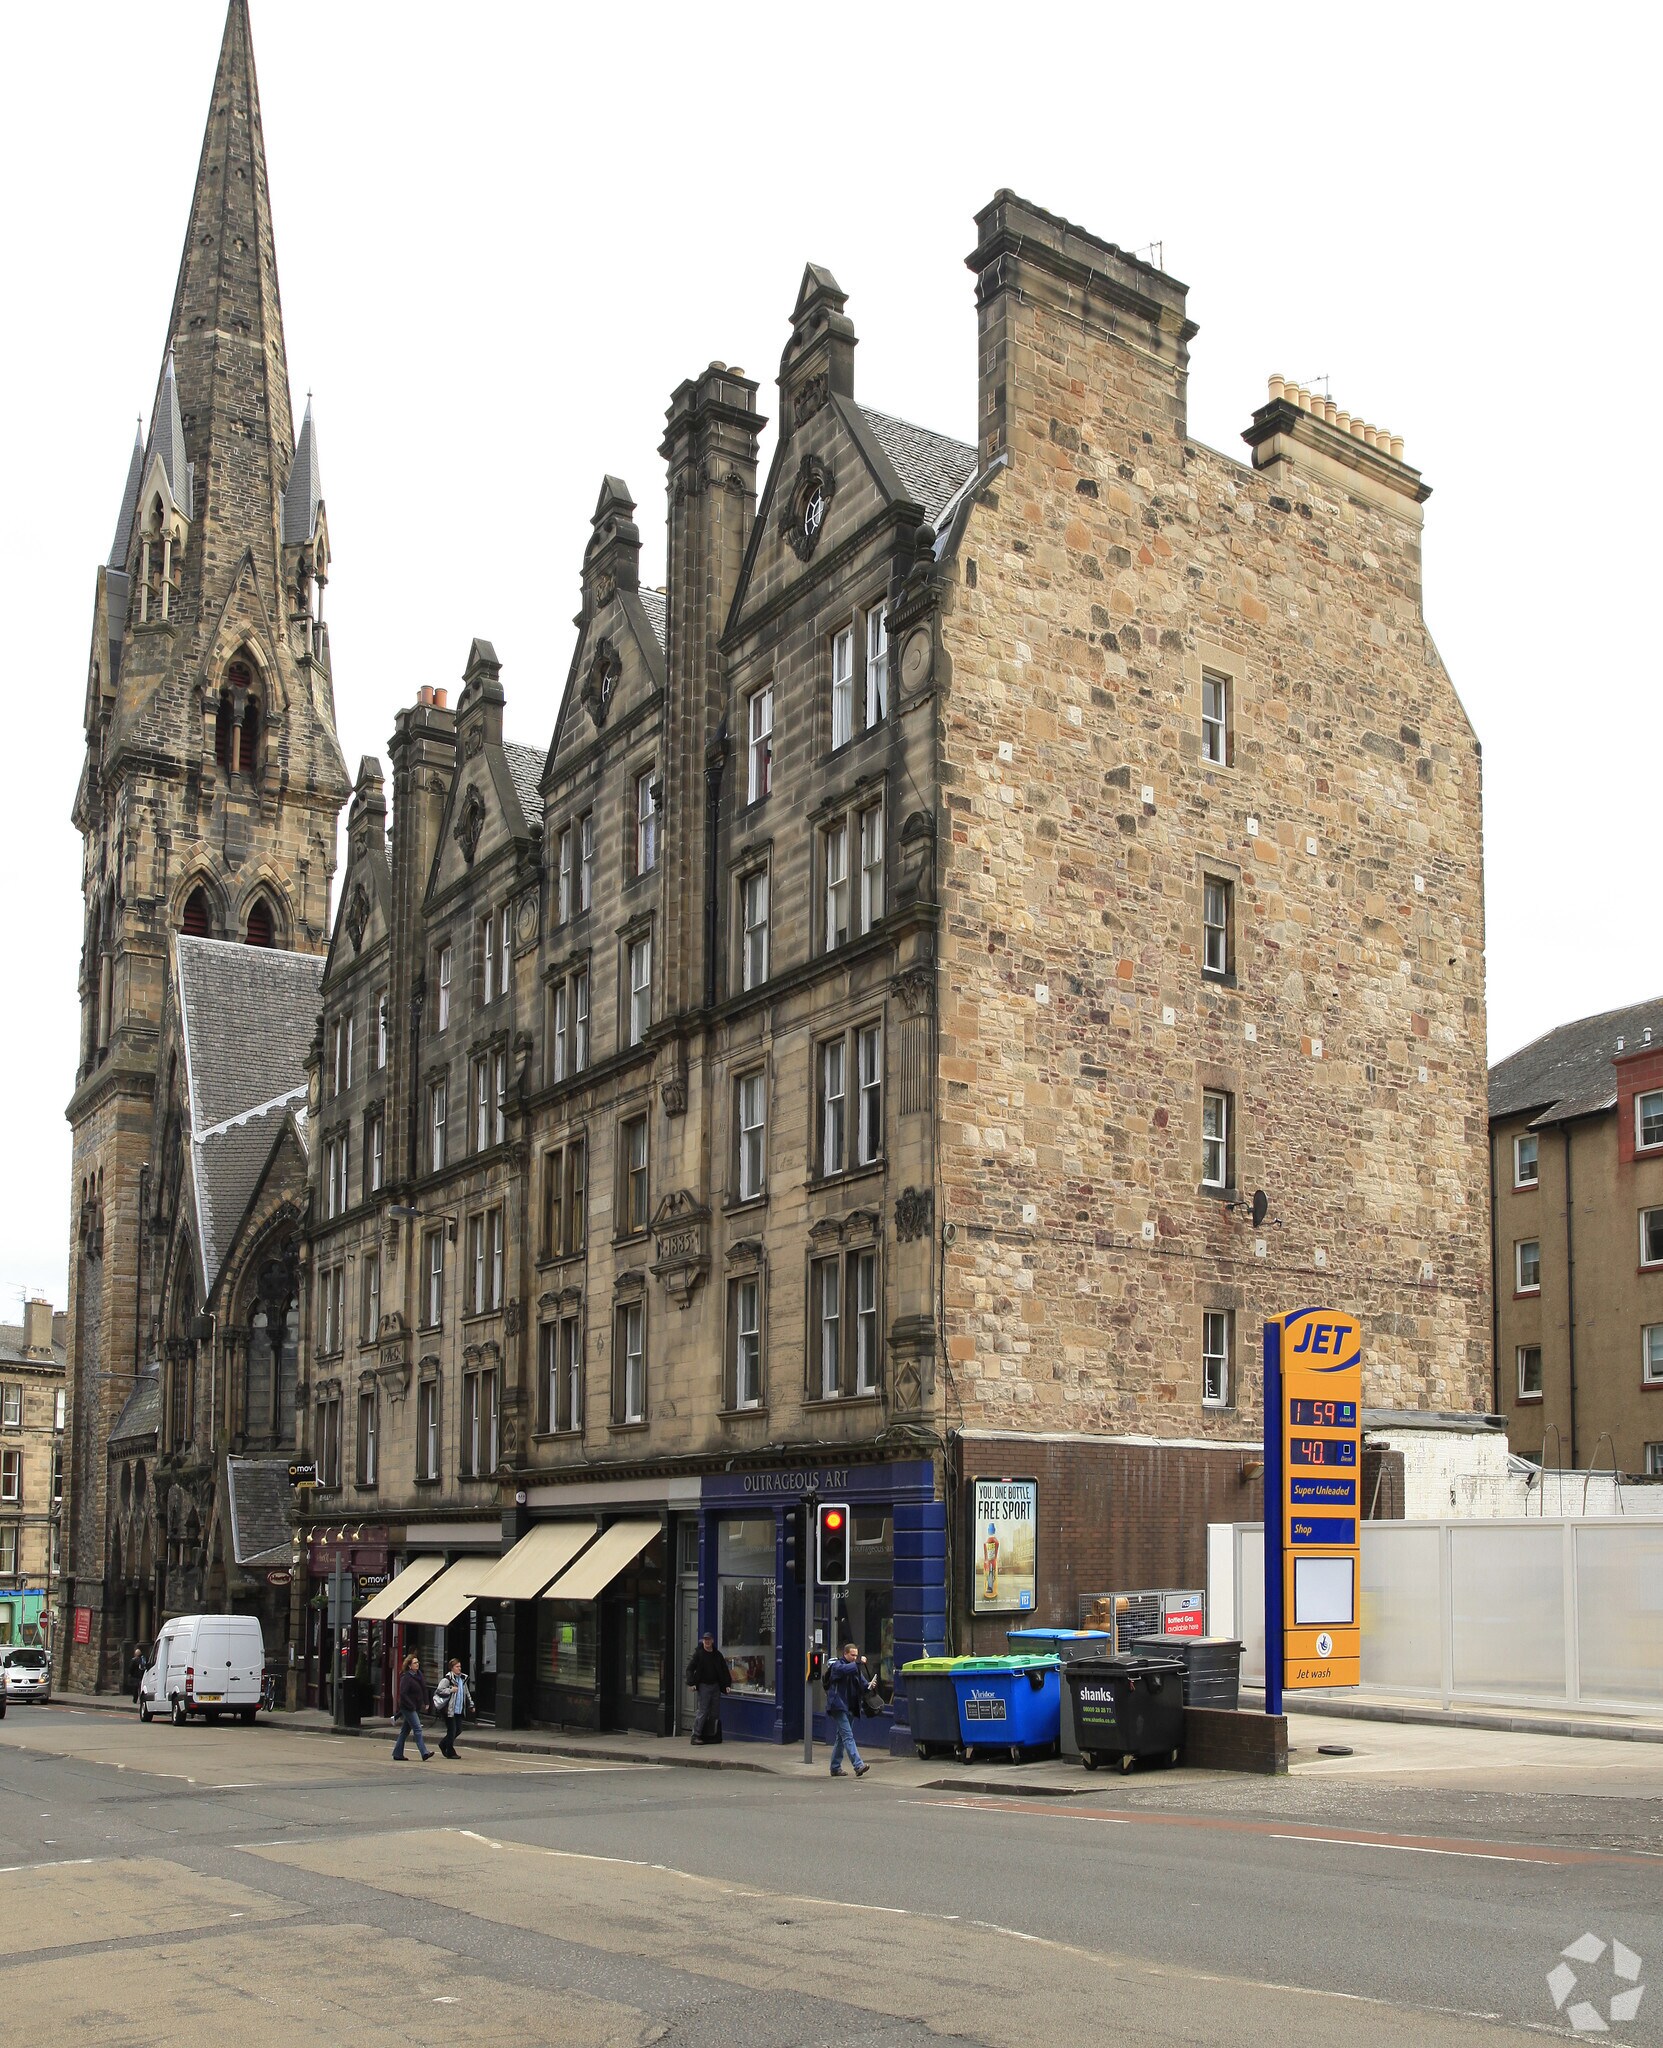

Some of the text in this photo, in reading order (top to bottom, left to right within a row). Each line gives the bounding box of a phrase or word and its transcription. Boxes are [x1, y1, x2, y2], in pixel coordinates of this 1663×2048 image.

[1293, 1322, 1353, 1355] JET
[743, 1470, 848, 1492] OUTRAGEOUS ART
[979, 1486, 1032, 1500] YOU. ONE BOTTLE.
[1294, 1485, 1350, 1499] Super Unleaded
[978, 1501, 1032, 1520] FREE SPORT
[1294, 1523, 1313, 1536] Shop
[1021, 1595, 1030, 1605] YES
[1167, 1616, 1184, 1624] Bottled
[1297, 1667, 1331, 1680] Jet wash
[971, 1690, 995, 1699] Viridor
[1080, 1686, 1114, 1701] shanks.
